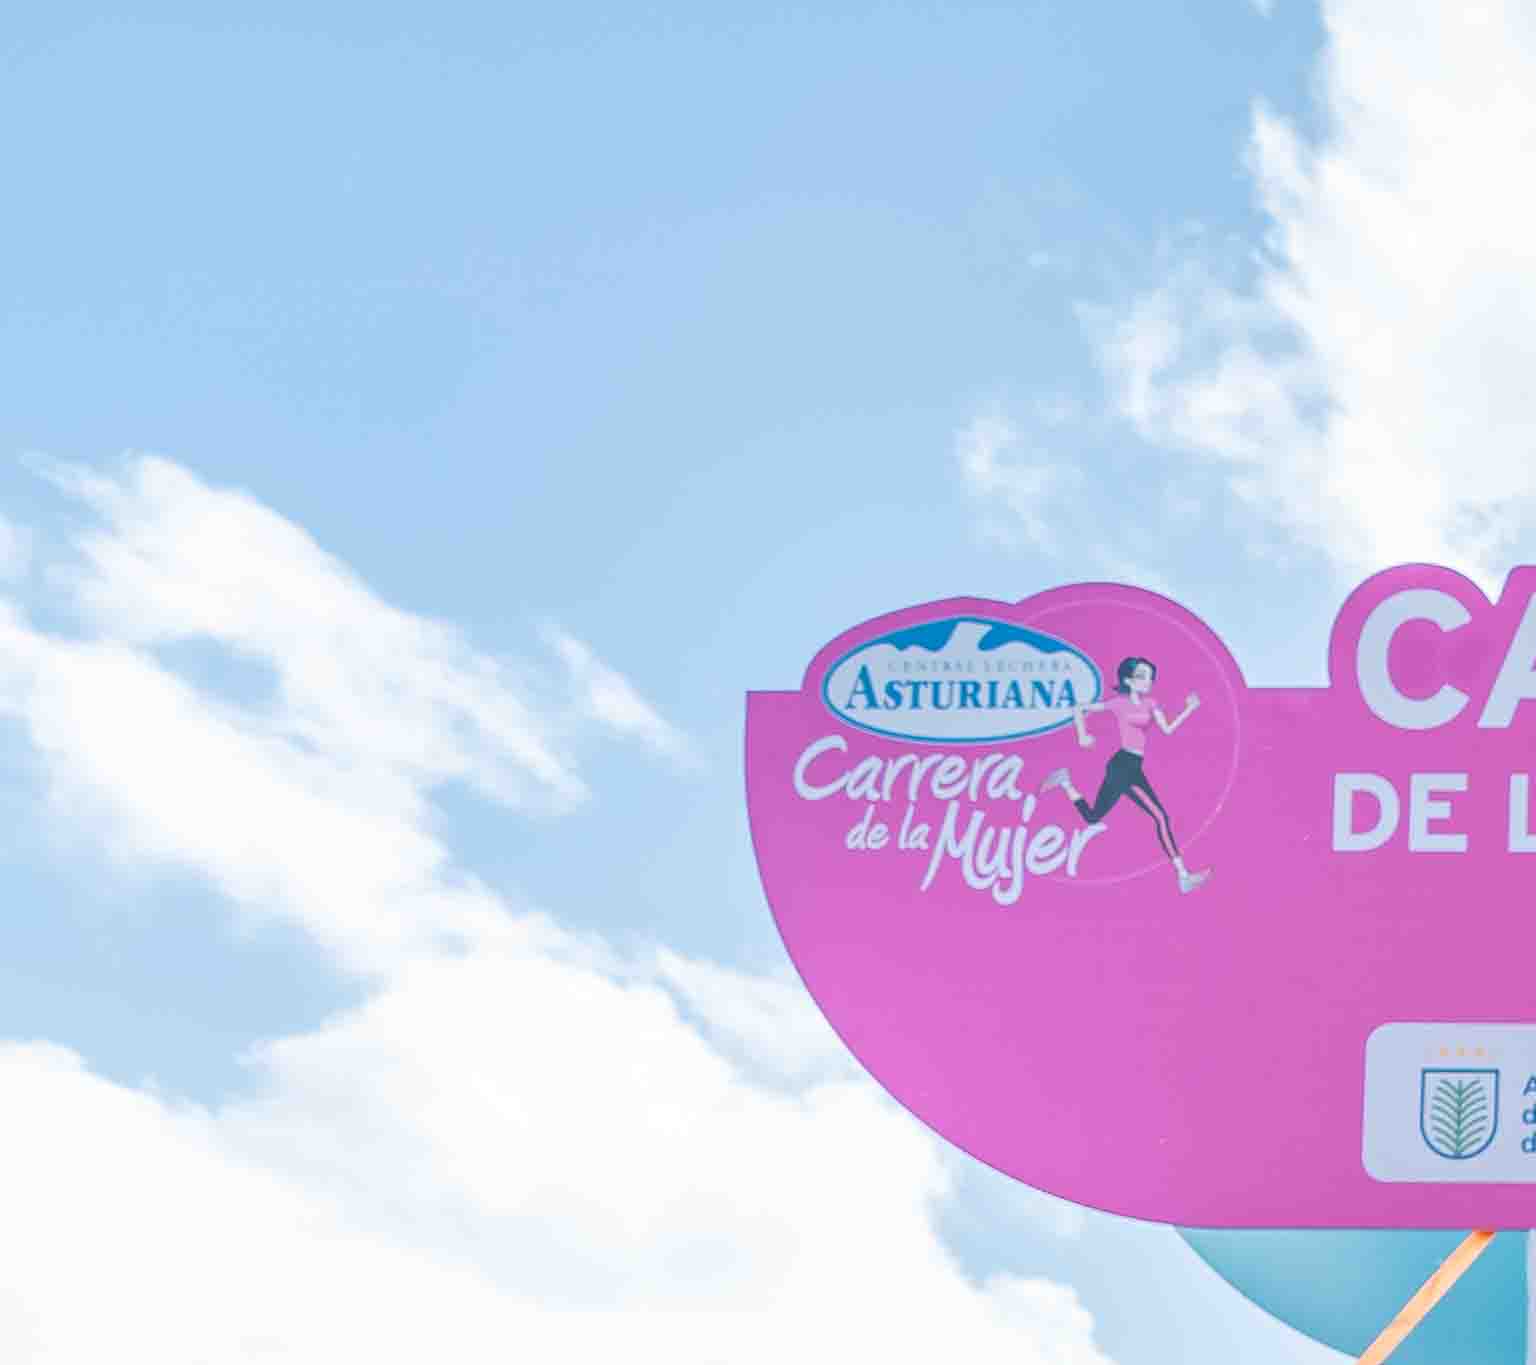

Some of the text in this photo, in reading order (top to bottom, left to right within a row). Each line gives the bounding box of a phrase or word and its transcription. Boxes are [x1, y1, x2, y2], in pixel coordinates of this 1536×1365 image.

[845, 663, 1078, 711] ASTURIANA
[793, 735, 1025, 802] Carrera
[1331, 772, 1470, 853] DE
[845, 794, 1108, 906] de la Mujer
